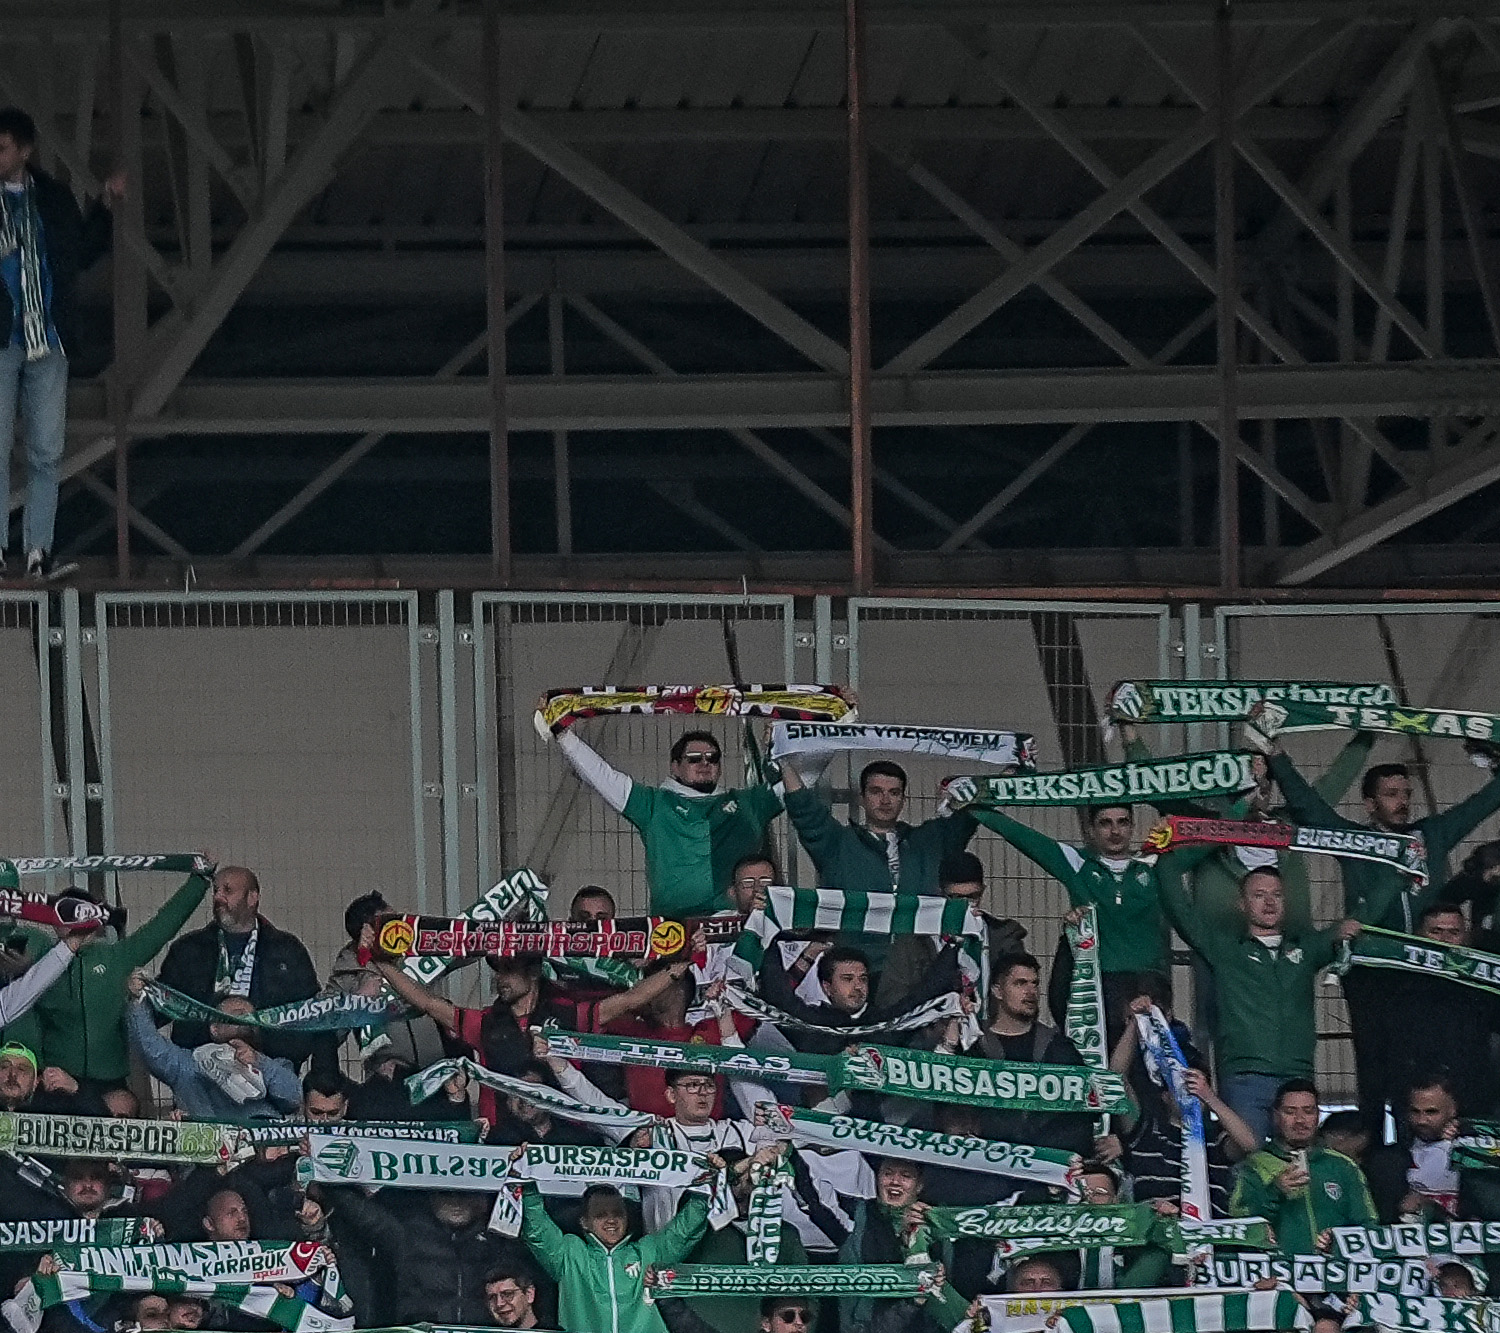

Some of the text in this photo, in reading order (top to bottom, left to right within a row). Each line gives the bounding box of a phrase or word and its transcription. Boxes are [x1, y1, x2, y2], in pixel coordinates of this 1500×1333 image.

[1332, 706, 1493, 739] TEXAS
[1296, 826, 1401, 857] BURSASPOR
[887, 1059, 1083, 1104] BURSASPOR
[18, 1117, 177, 1155] BURSASPOR
[525, 1146, 688, 1172] BURSASPOR
[554, 1166, 661, 1180] ANLAYAN ANLADI
[955, 1204, 1129, 1239] Bursaspor
[202, 1249, 288, 1278] KARABÜK
